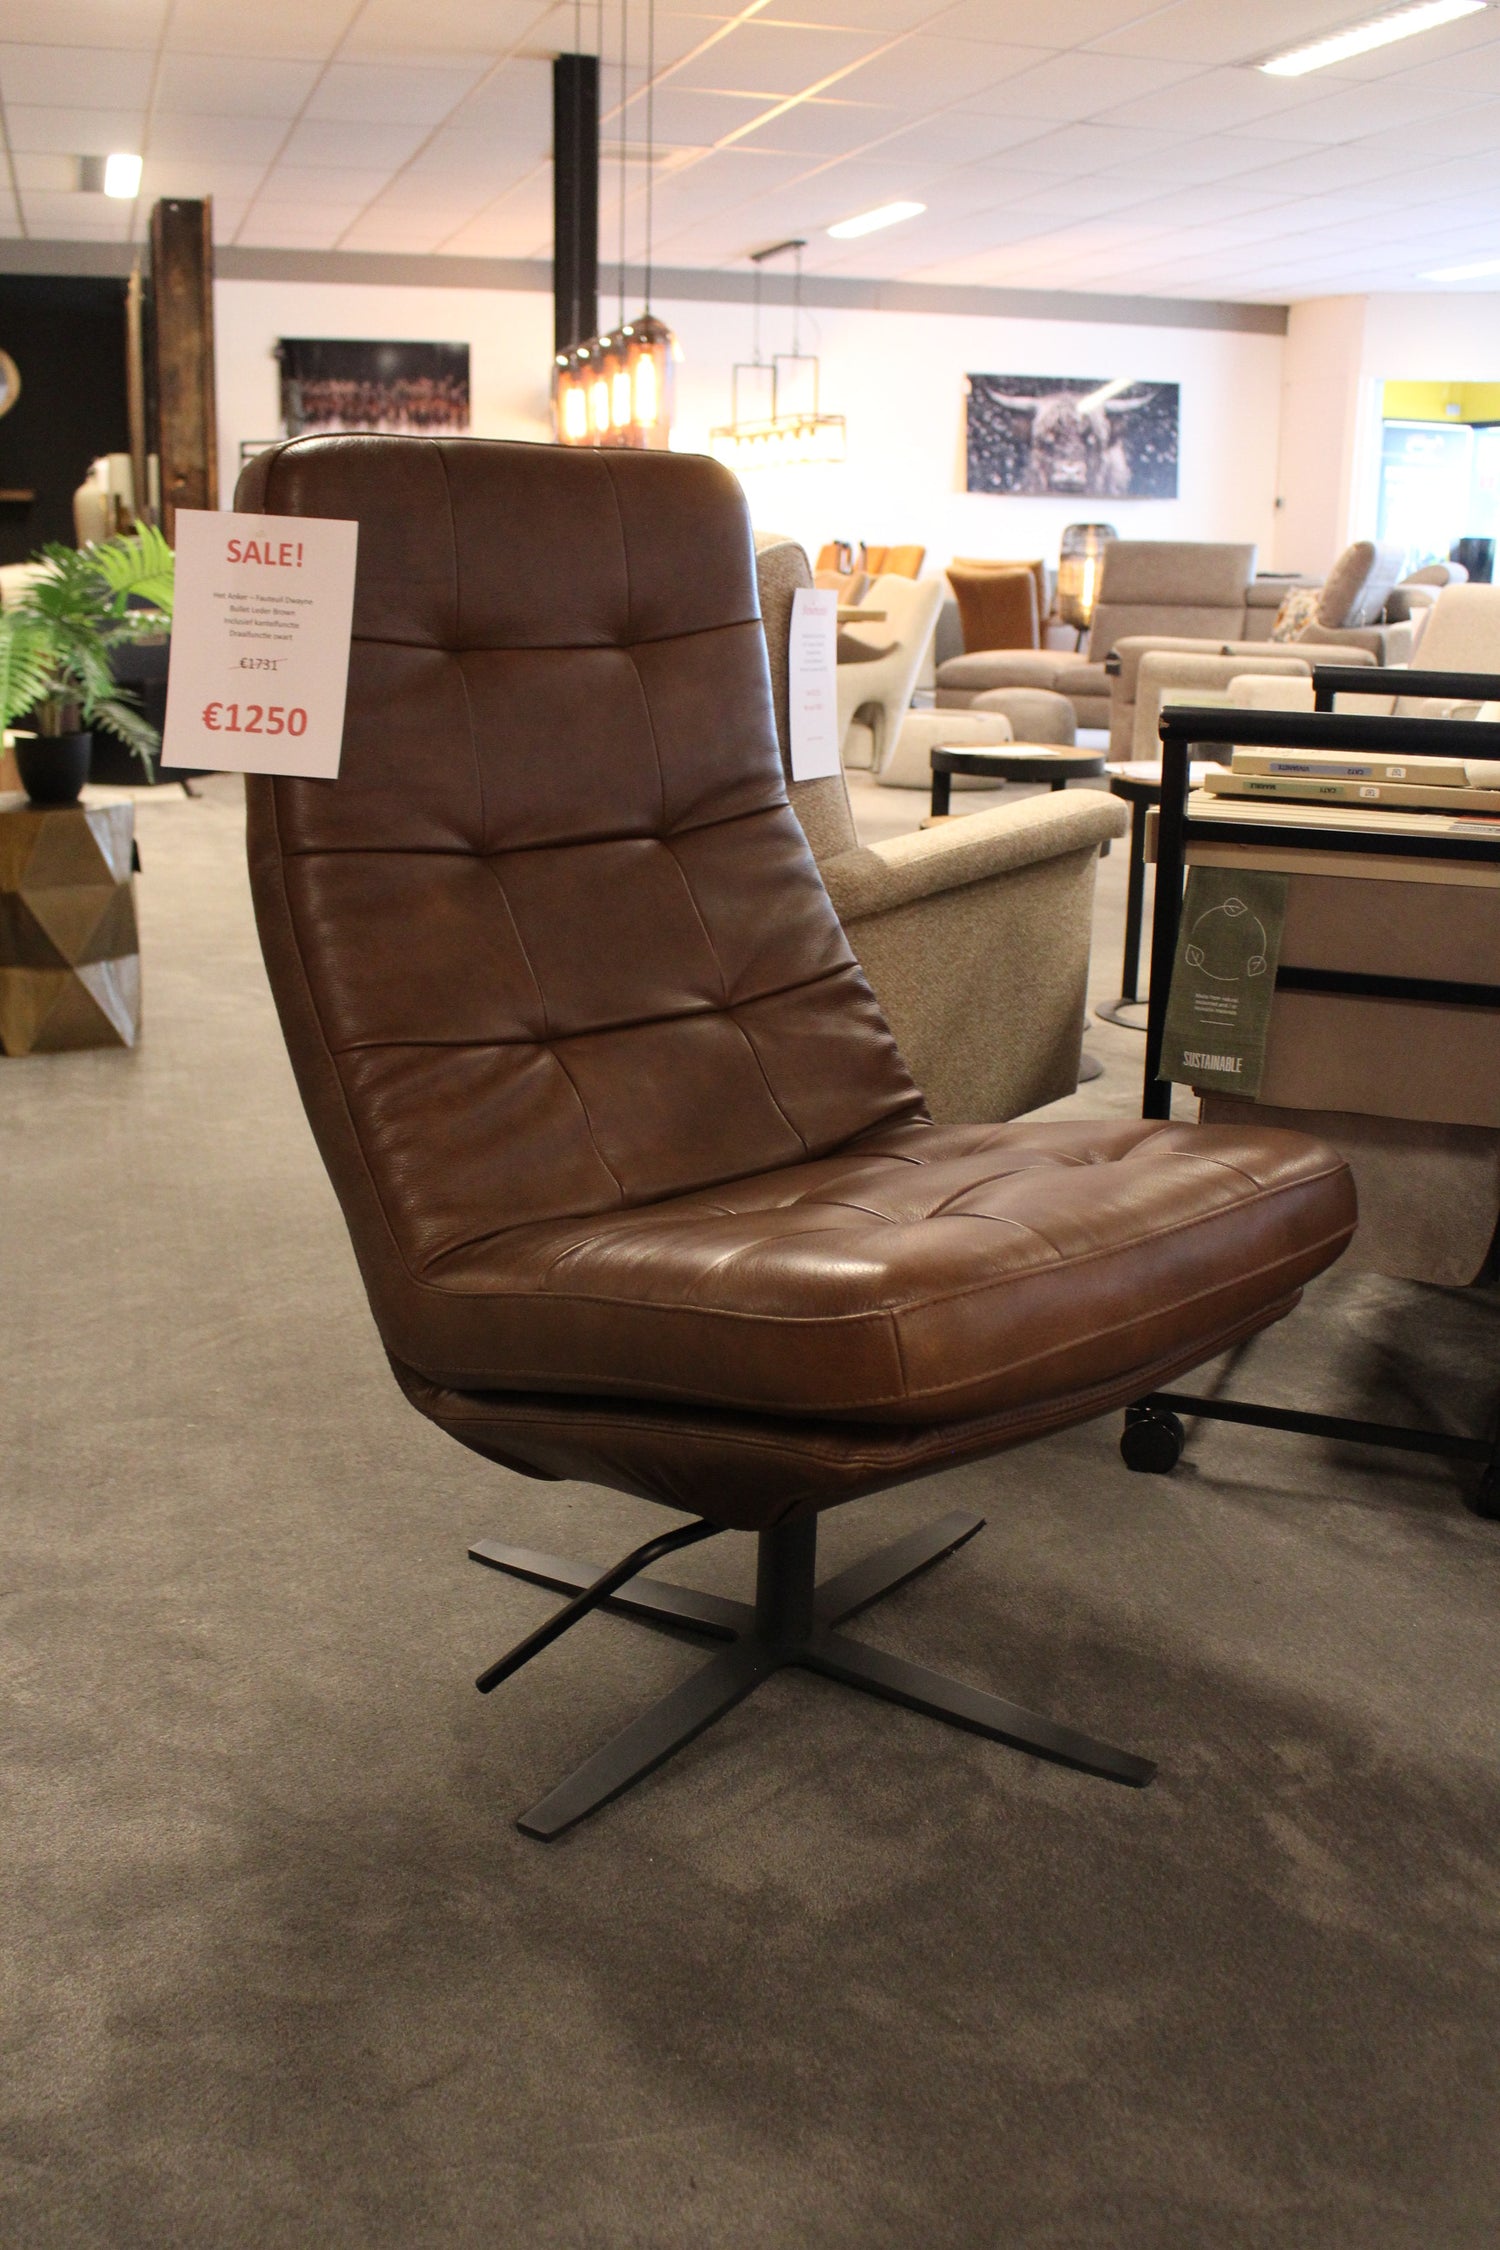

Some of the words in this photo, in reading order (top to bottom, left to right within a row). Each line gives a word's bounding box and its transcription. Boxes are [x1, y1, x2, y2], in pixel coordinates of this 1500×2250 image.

[226, 538, 304, 568] SALE!
[228, 592, 248, 600] Anker
[256, 593, 283, 603] Fauteuil
[285, 596, 313, 605] Dwayne
[251, 607, 271, 615] Leder
[273, 607, 295, 616] Brown
[224, 617, 253, 626] Inclusief
[254, 618, 300, 629] kantelfunctie
[240, 657, 277, 670] €1731
[202, 701, 308, 737] €1250
[1347, 768, 1365, 776] CAT2
[1183, 1050, 1244, 1073] SUSTAINABLE
